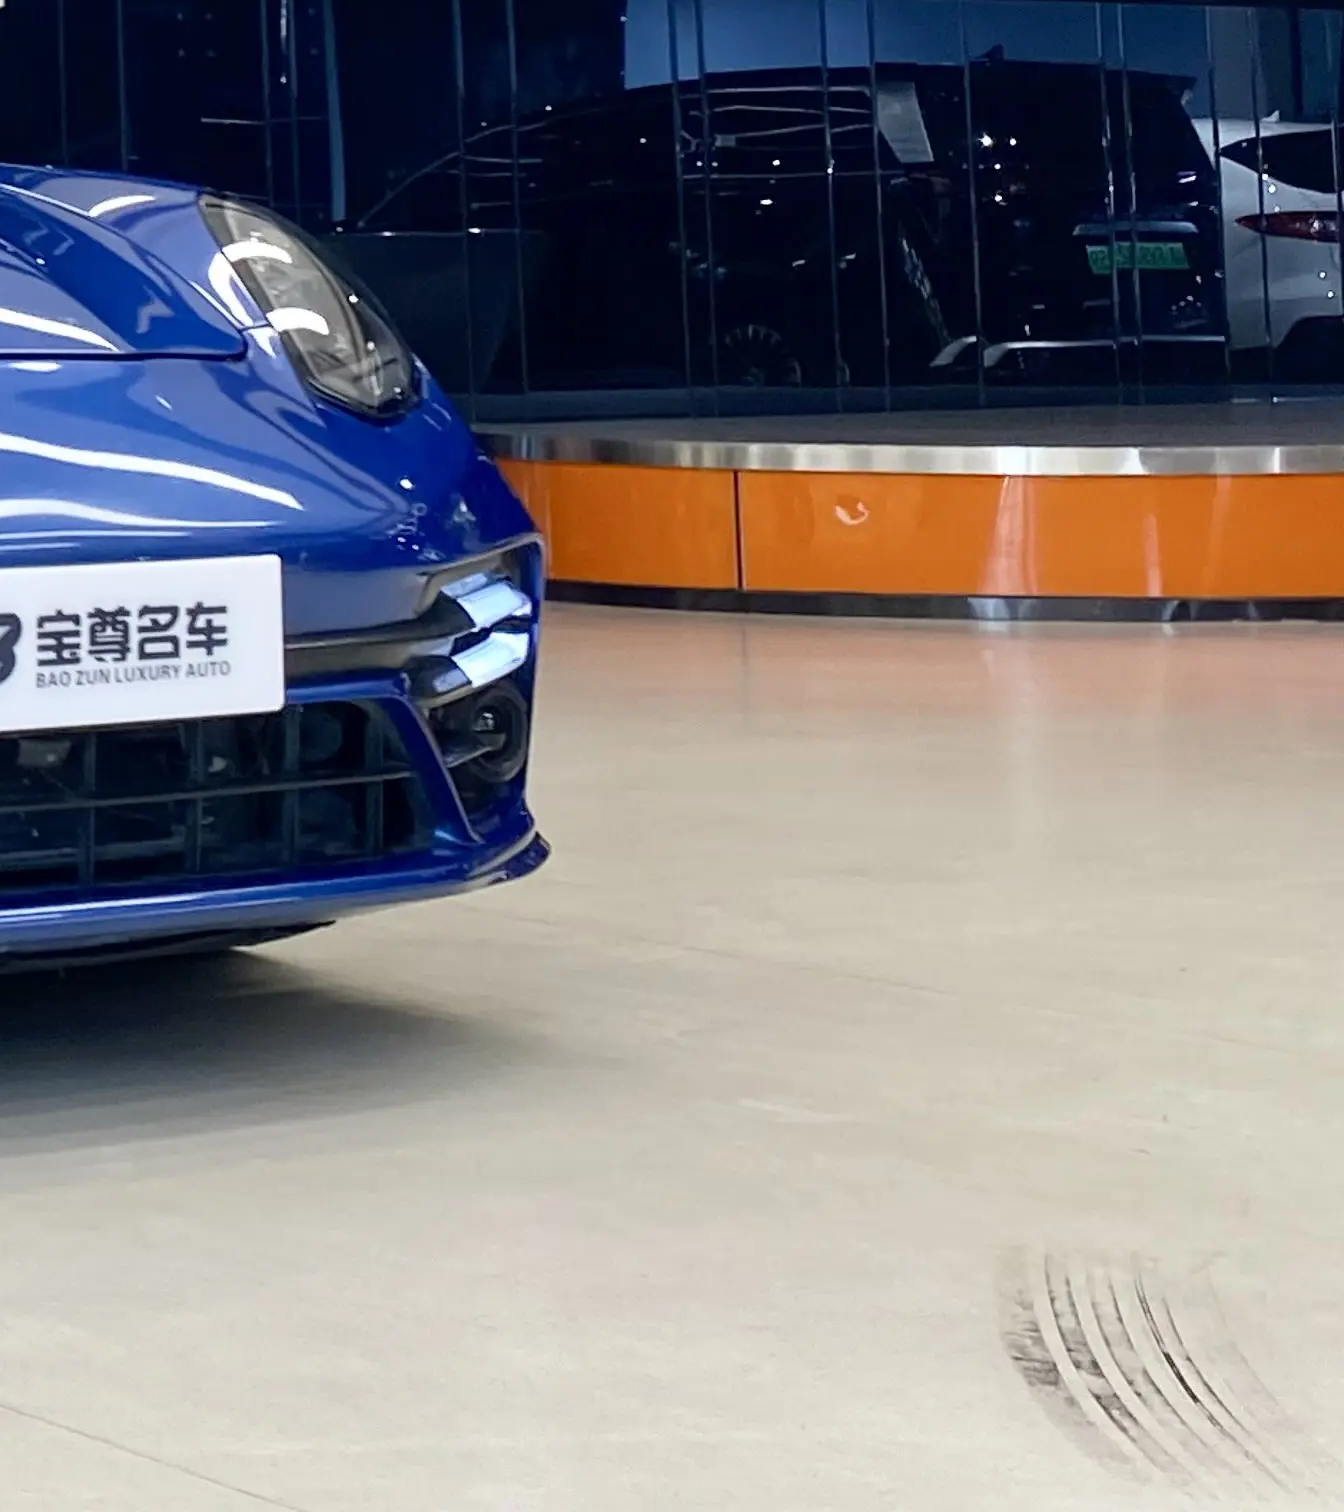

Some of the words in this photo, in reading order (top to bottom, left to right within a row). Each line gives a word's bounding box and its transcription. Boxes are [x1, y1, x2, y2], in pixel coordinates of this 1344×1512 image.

[36, 601, 229, 667] 宝尊名车
[35, 670, 71, 688] BAO
[75, 669, 111, 687] ZUN
[114, 663, 182, 685] LUXURY
[185, 660, 232, 679] AUTO
